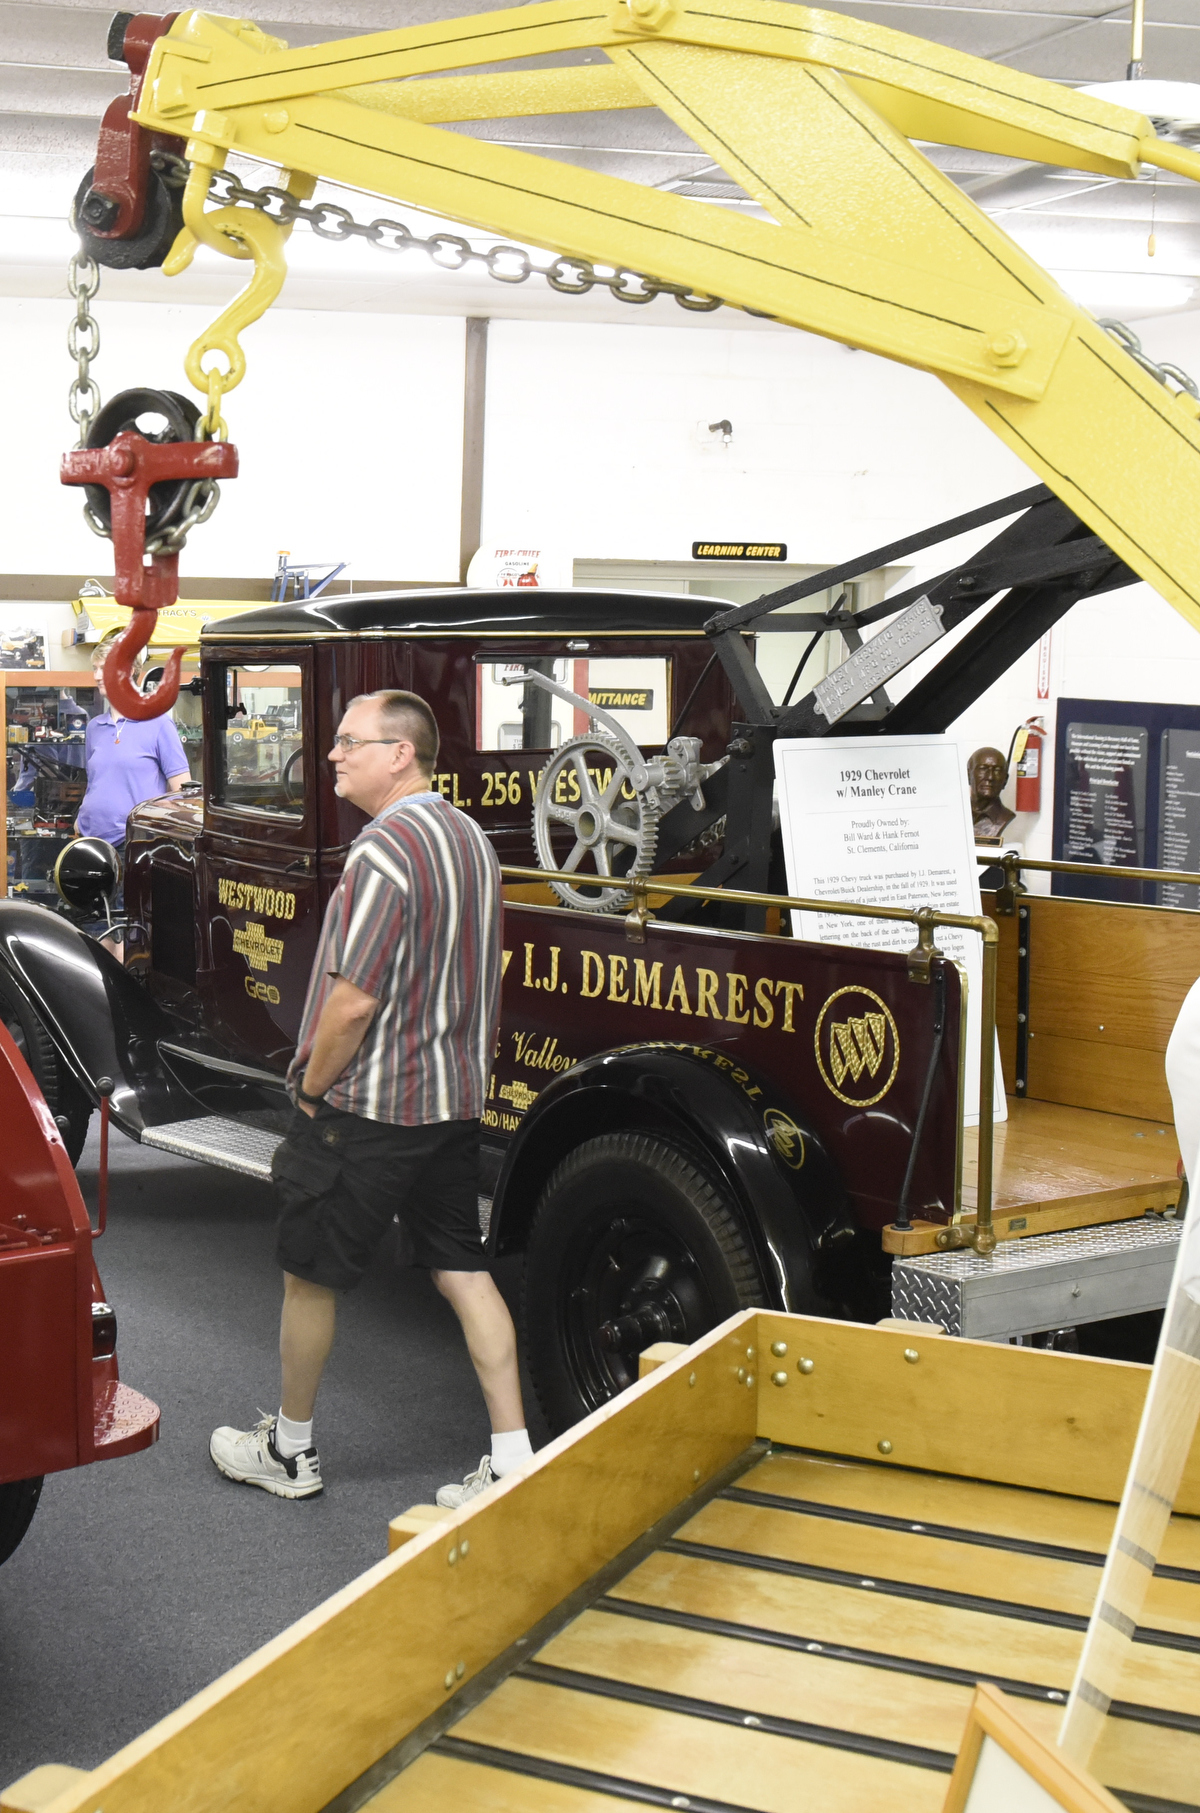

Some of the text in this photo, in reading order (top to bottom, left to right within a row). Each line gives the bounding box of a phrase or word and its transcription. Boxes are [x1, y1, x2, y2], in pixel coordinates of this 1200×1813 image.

[494, 549, 541, 558] FIRE-CHIEF
[697, 545, 781, 557] LEARNING CENTER
[158, 609, 197, 617] TRACY'S
[851, 630, 894, 668] WRECKING
[896, 604, 926, 631] CRANE
[589, 693, 647, 705] MITTANCE
[825, 677, 855, 708] MANLEY
[840, 768, 910, 782] 1929 Chevrolet
[430, 773, 471, 807] TEL.
[481, 771, 521, 806] 256
[836, 784, 917, 799] w/ Manley Crane
[851, 818, 910, 830] Proudly Owned by:
[843, 833, 856, 842] Bill
[857, 832, 873, 841] Ward
[874, 831, 881, 840] &
[882, 831, 899, 839] Hank
[847, 842, 919, 855] St. Clements, California
[827, 876, 840, 884] 1929
[841, 875, 857, 883] Chevy
[885, 871, 909, 880] purchased
[218, 878, 296, 920] WESTWOOD
[866, 895, 877, 904] junk
[878, 894, 890, 903] yard
[840, 920, 855, 928] York,
[948, 933, 963, 941] Chevy
[235, 937, 282, 956] CHEVROLET
[523, 943, 568, 994] I.J.
[580, 950, 804, 1033] DEMAREST
